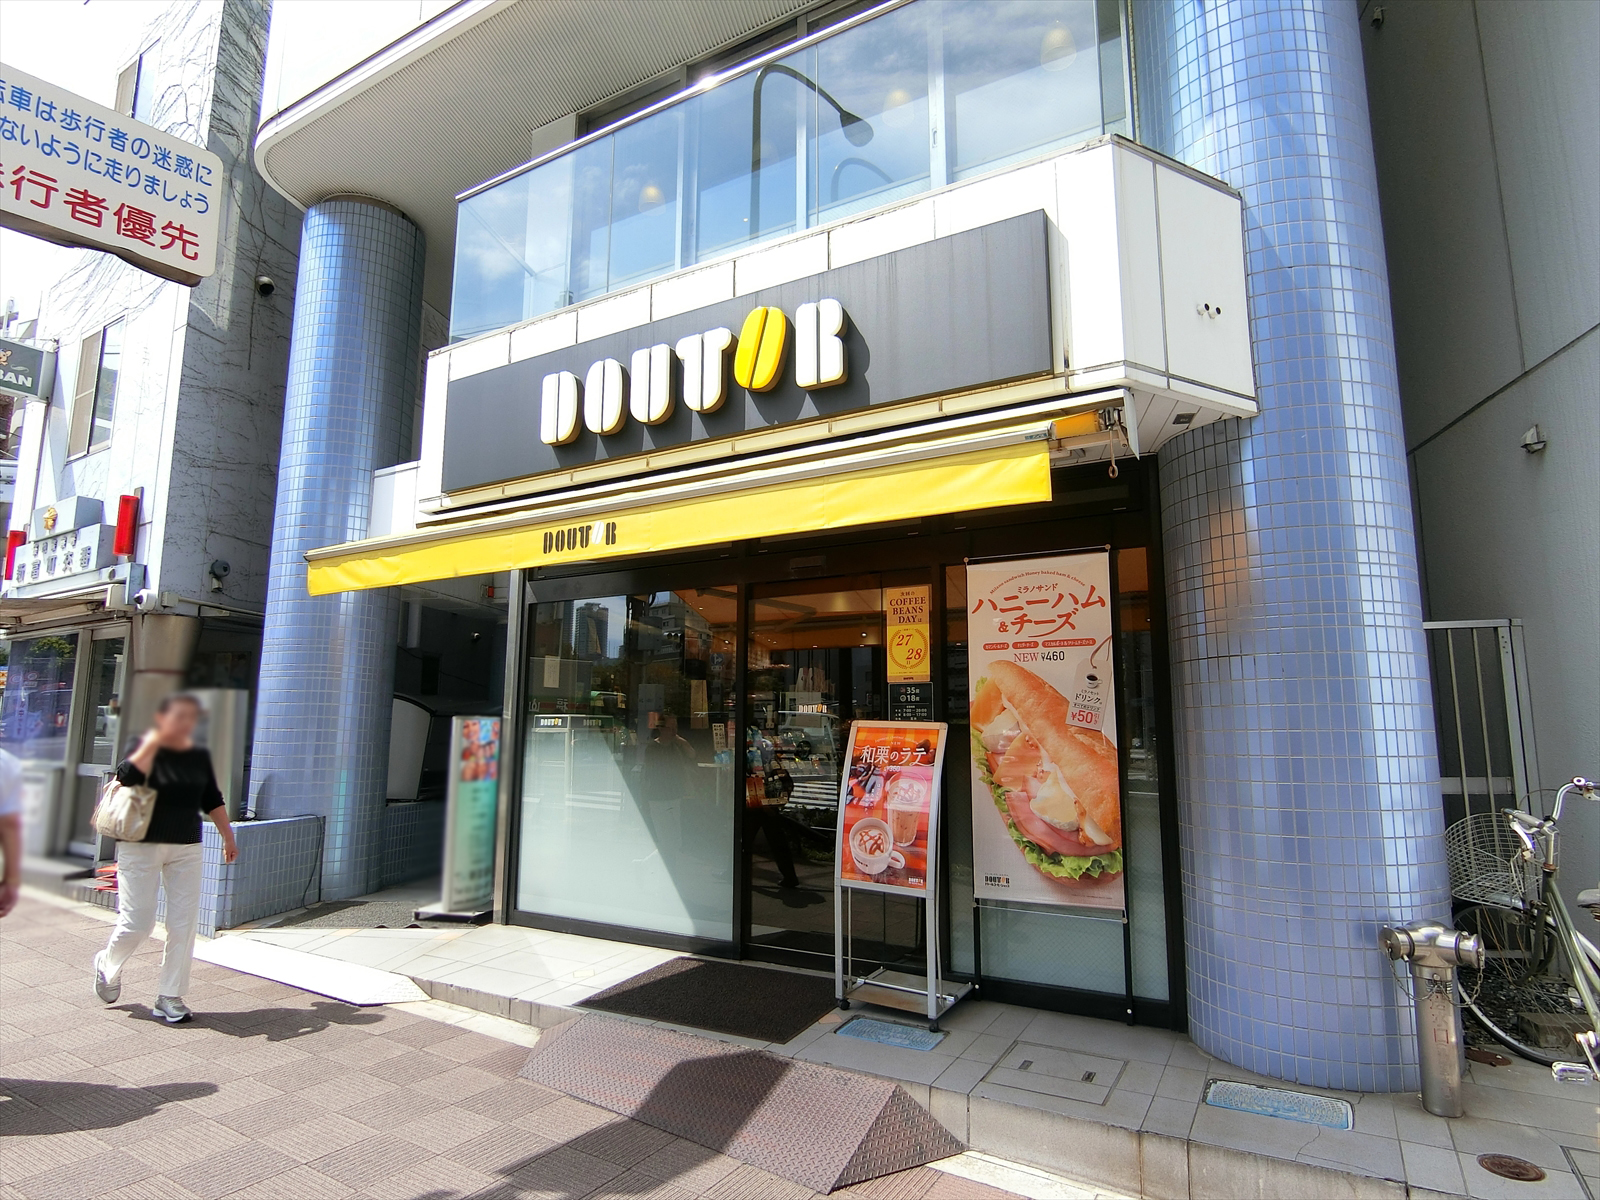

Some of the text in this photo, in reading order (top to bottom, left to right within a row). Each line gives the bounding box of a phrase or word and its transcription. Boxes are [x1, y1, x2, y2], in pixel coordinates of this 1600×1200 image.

[0, 79, 212, 187] 車は歩行者の迷惑に
[0, 162, 200, 261] 行者優先
[540, 298, 848, 446] DOUTOR
[543, 522, 617, 554] DOUTOR
[1004, 573, 1025, 584] sandwich
[1017, 583, 1059, 594] ミラノサンド
[889, 596, 927, 607] COFFEE
[971, 584, 1106, 615] ハニーハム
[892, 606, 924, 615] BEANS
[896, 634, 913, 646] 27
[906, 648, 923, 660] 28
[1013, 650, 1065, 663] NEW ¥460
[798, 704, 827, 713] DOUTOR
[1071, 709, 1094, 724] ¥50
[860, 745, 927, 766] 和栗のラテ
[984, 875, 1010, 884] DOUTOR
